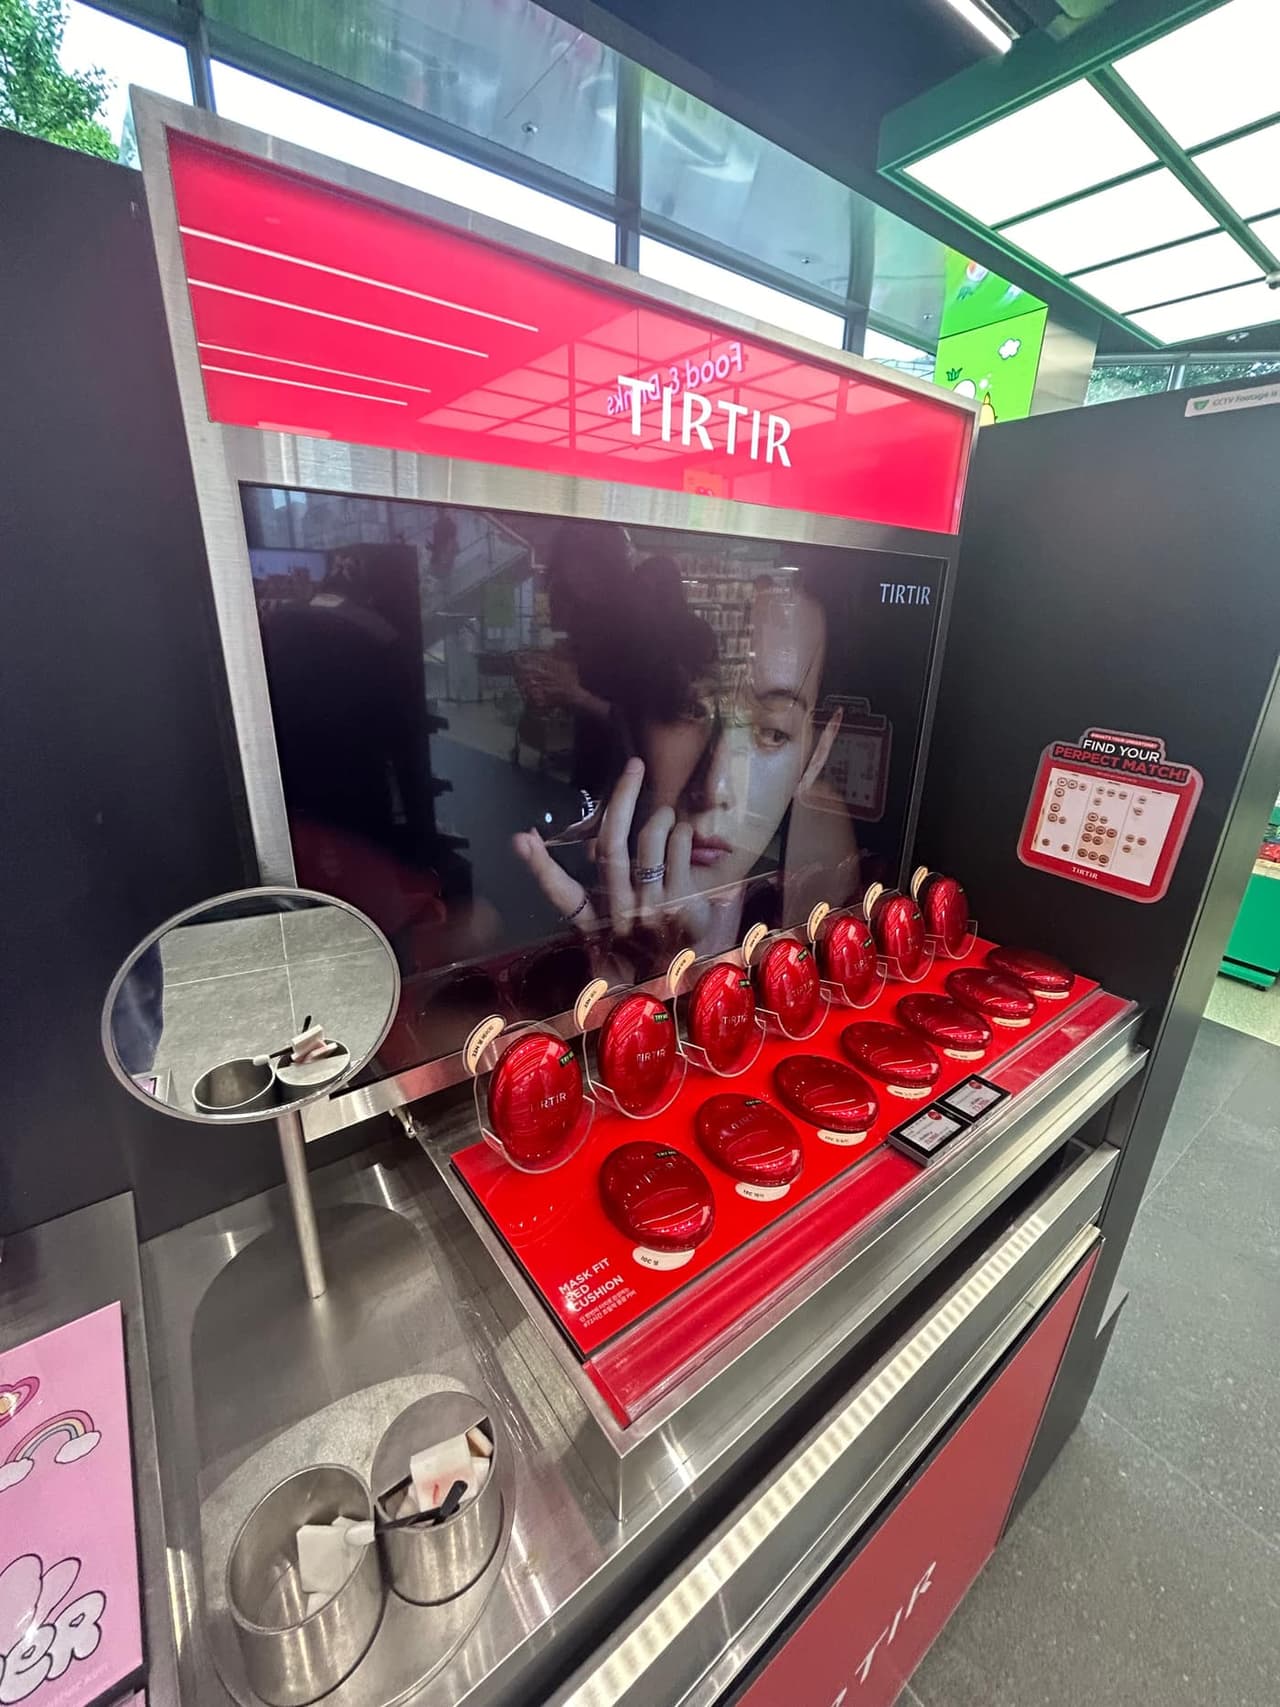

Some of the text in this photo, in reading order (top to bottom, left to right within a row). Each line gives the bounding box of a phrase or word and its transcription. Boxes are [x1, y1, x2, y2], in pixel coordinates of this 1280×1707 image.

[617, 374, 792, 468] TIRTIR
[879, 583, 931, 606] TIRTIR
[1083, 739, 1117, 754] FIND
[1119, 745, 1161, 763] YOUR
[1122, 759, 1189, 782] MATCH!
[558, 1257, 610, 1295] MASK FIT
[565, 1284, 590, 1304] RED
[570, 1274, 624, 1312] CUSHION
